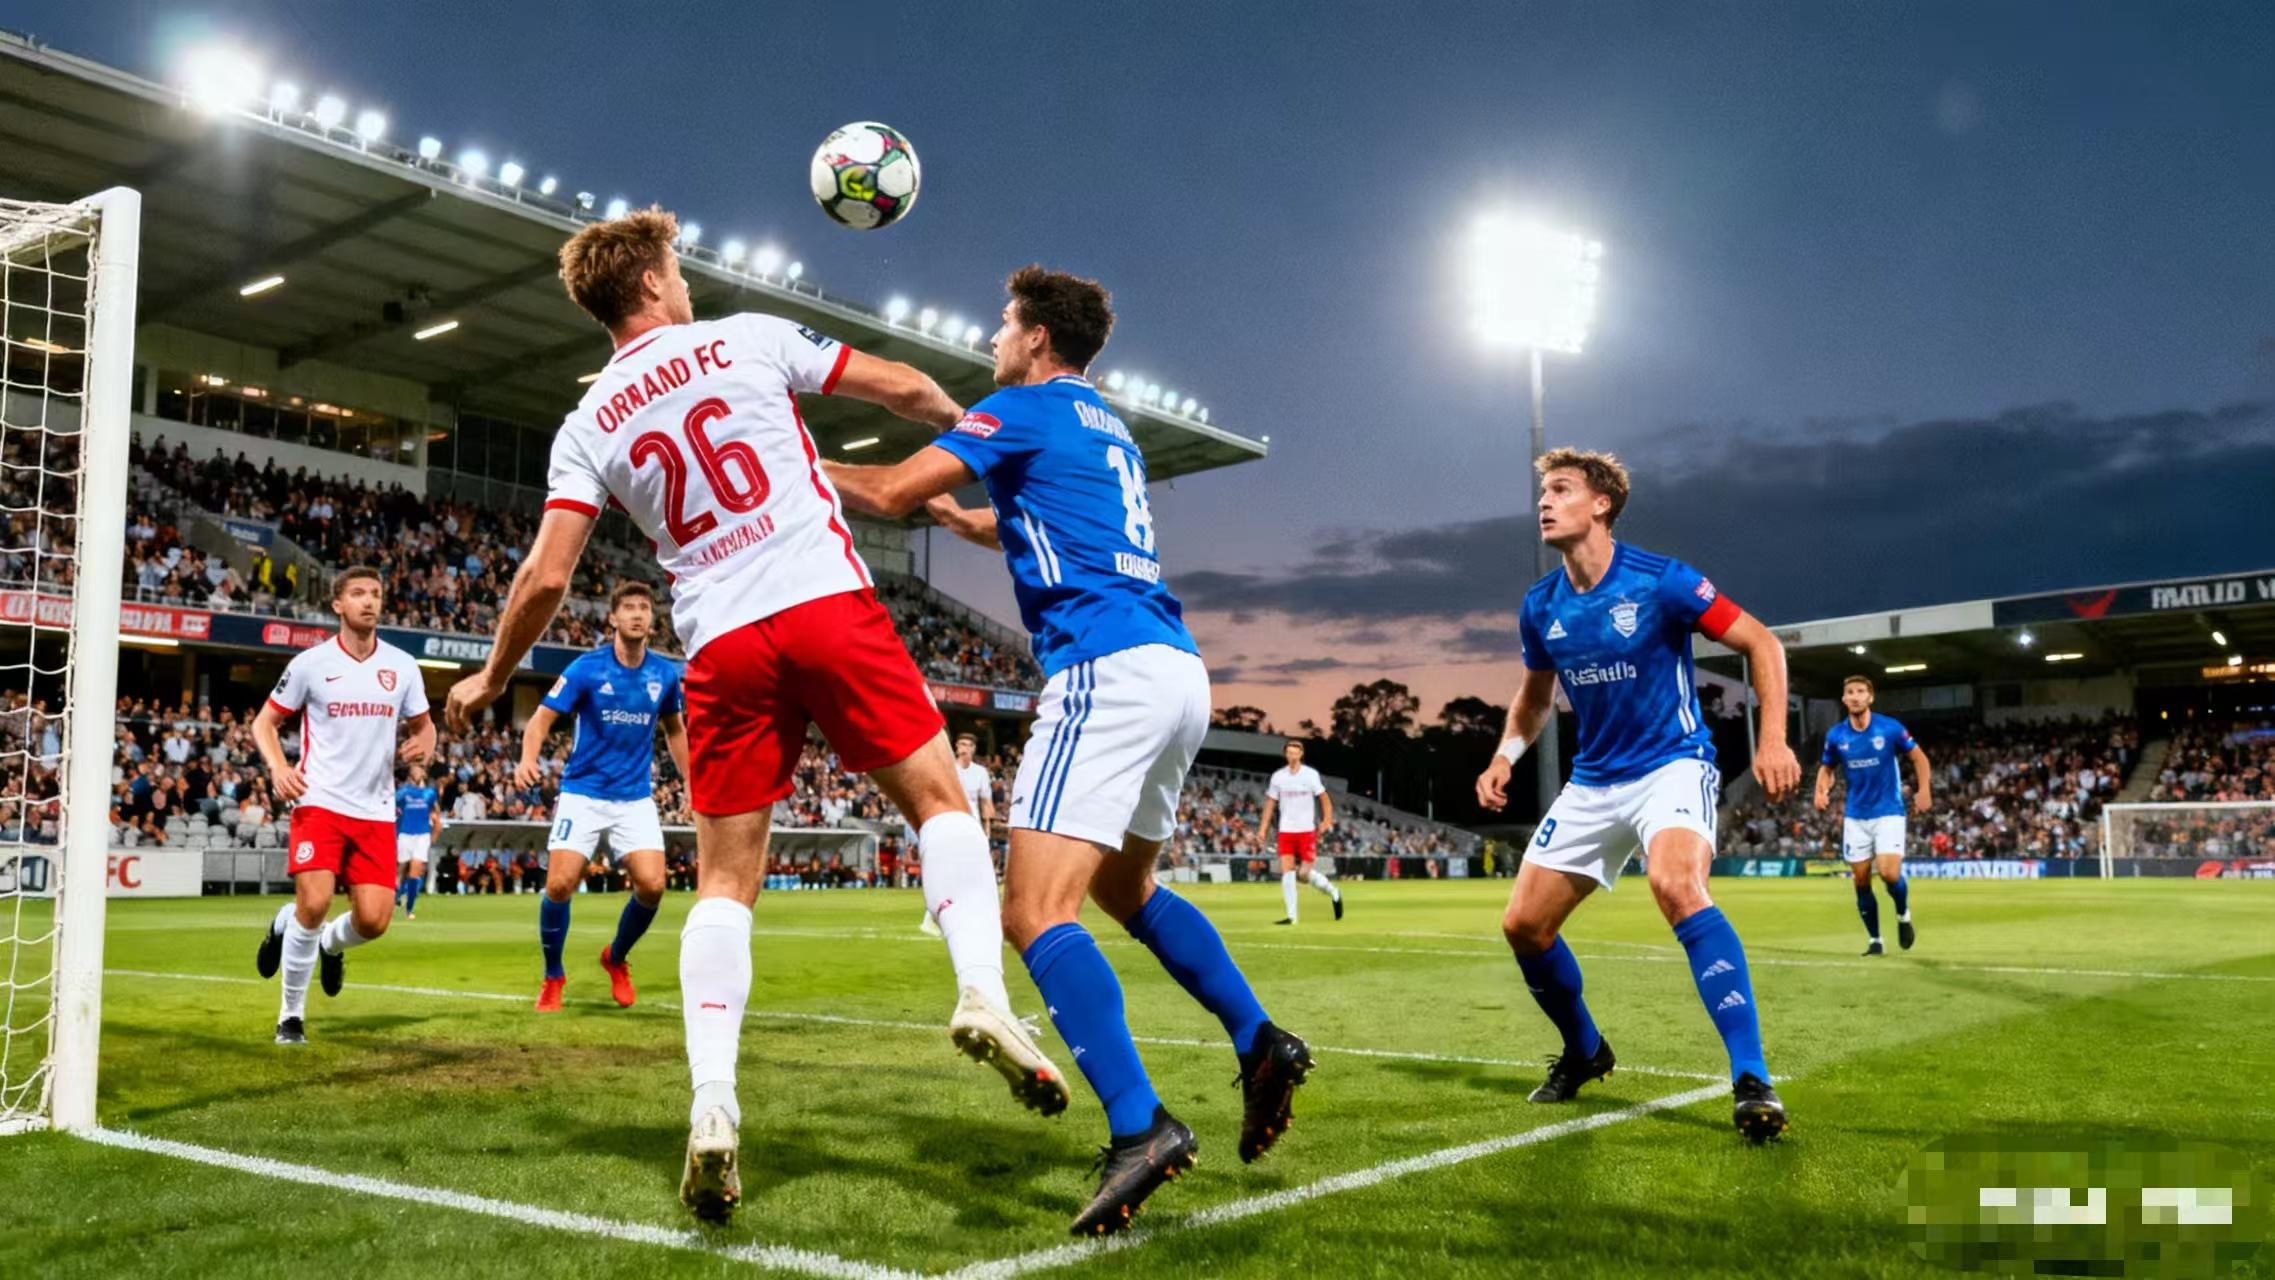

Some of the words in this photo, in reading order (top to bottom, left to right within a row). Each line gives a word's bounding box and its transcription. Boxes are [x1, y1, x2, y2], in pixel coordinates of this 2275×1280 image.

[693, 339, 732, 376] FC
[629, 397, 771, 548] 26
[106, 855, 142, 889] FC
